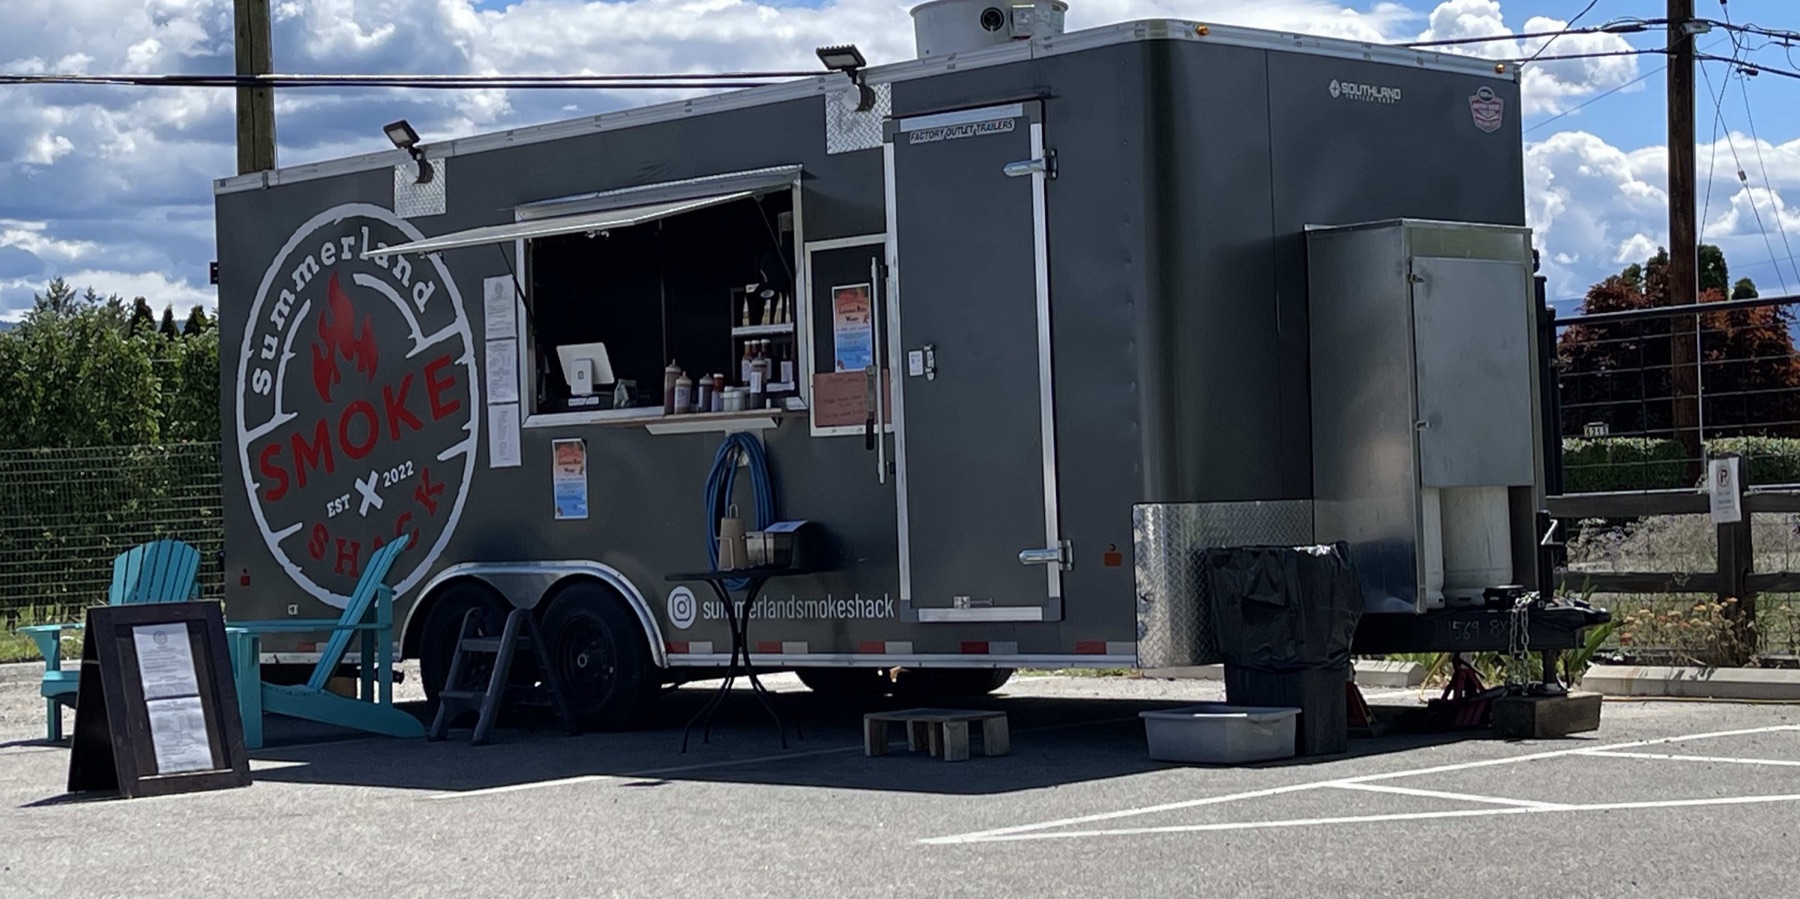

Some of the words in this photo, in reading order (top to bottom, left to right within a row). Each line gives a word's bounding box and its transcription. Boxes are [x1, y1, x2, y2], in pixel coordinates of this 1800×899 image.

[1341, 82, 1401, 100] SOUTHLAND
[910, 128, 945, 142] FACTORY
[945, 125, 975, 138] OUTLET
[975, 120, 1013, 135] TRAILERS
[252, 225, 436, 396] Summerland
[259, 354, 461, 502] SMOKE
[326, 494, 351, 518] EST
[383, 460, 415, 488] 2022
